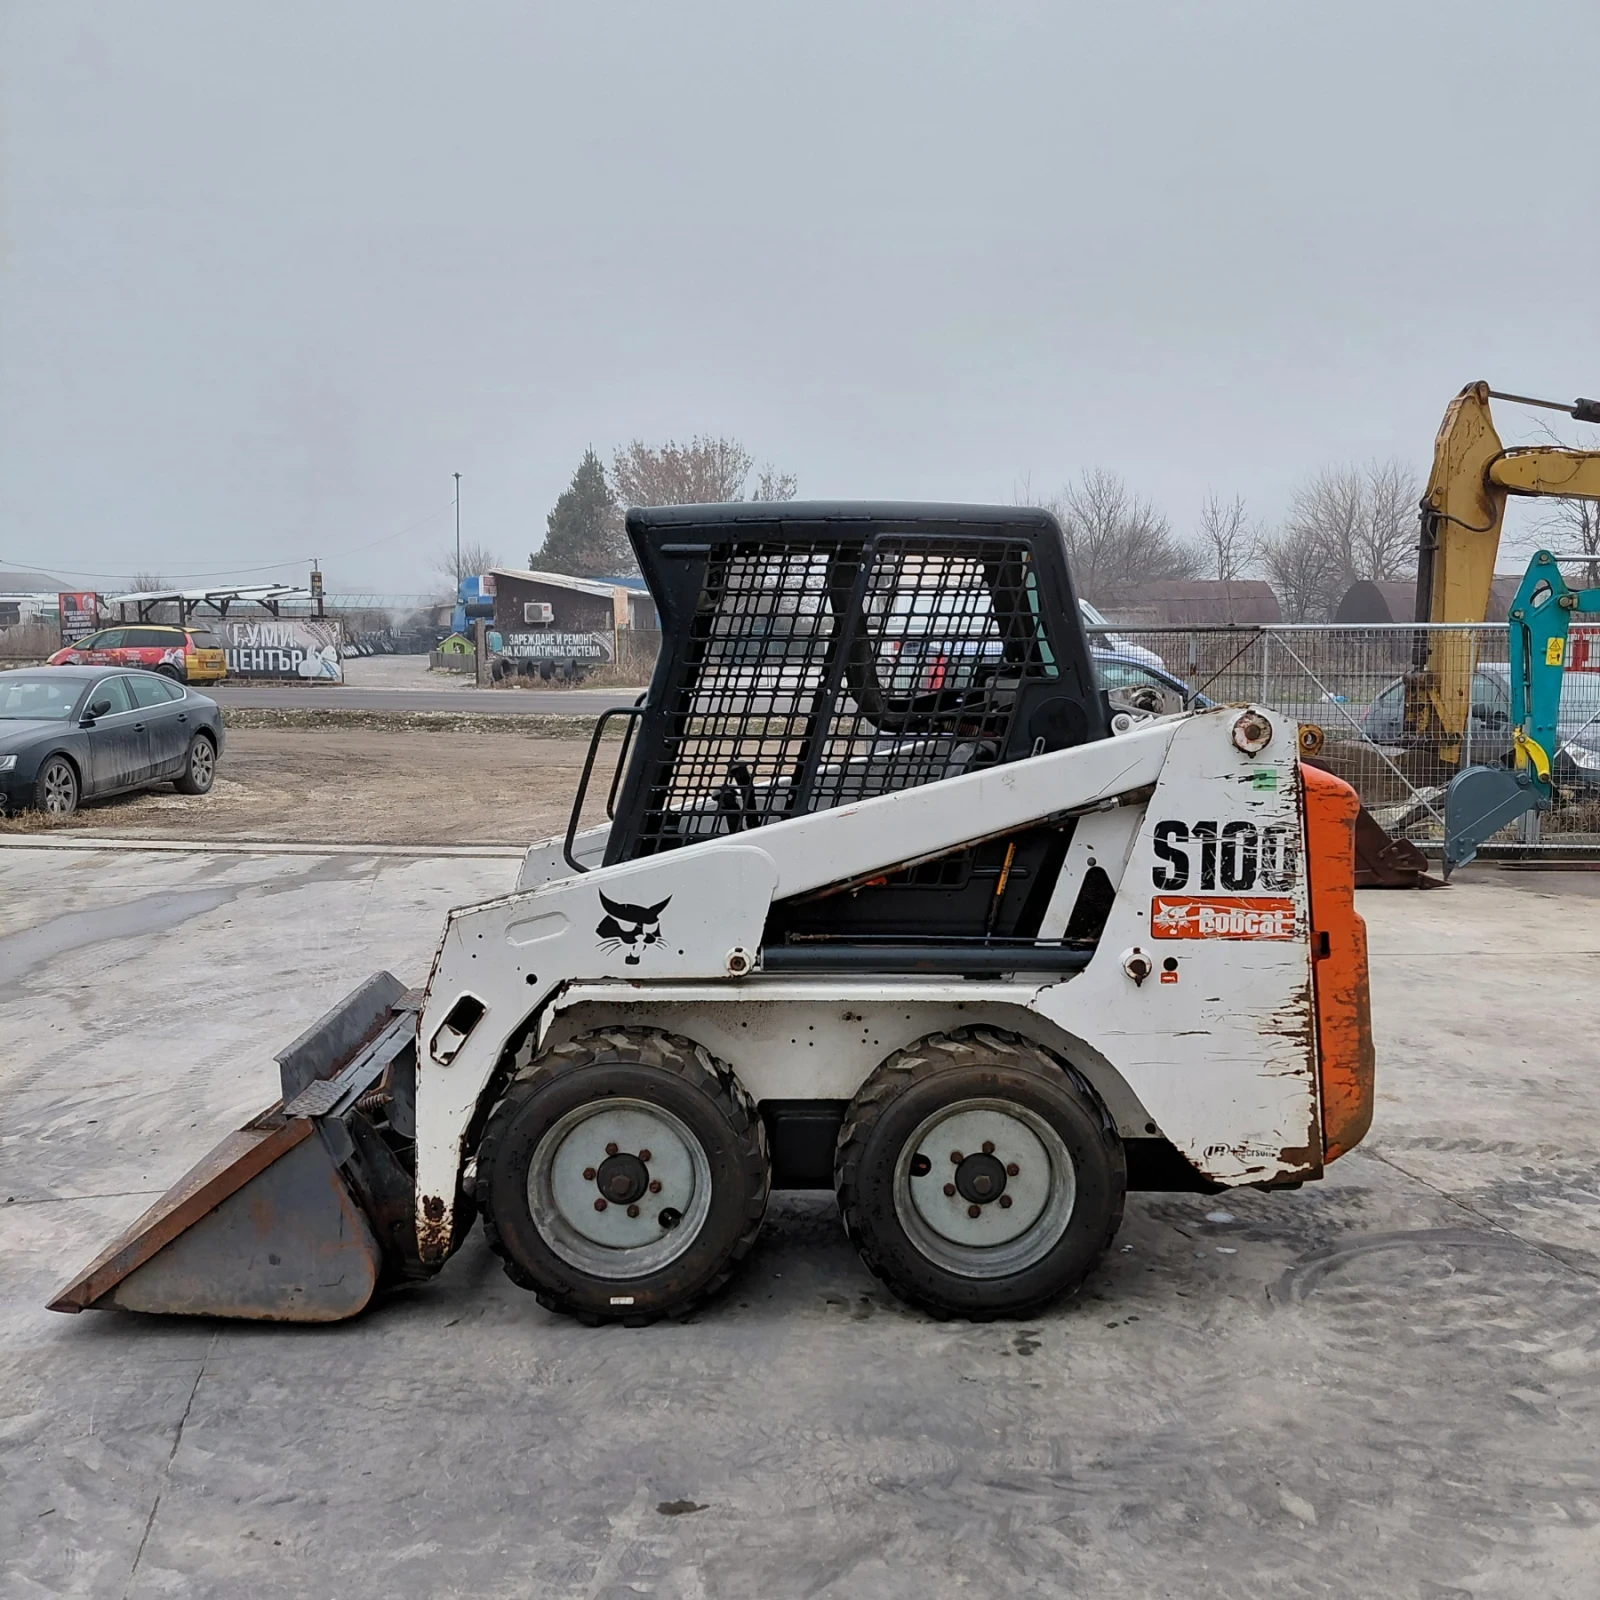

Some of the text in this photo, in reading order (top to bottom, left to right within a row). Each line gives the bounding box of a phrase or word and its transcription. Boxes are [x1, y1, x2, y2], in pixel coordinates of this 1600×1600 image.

[233, 623, 295, 647] ГУМИ
[509, 634, 593, 645] ЗАРЕЖДАНЕ И РЕМОНТ
[225, 649, 303, 672] ЦЕНТЪР
[502, 646, 600, 657] НА КЛИМАТИЧНА СИСТЕМА
[1152, 820, 1296, 892] S100
[1199, 907, 1283, 934] Bobcat
